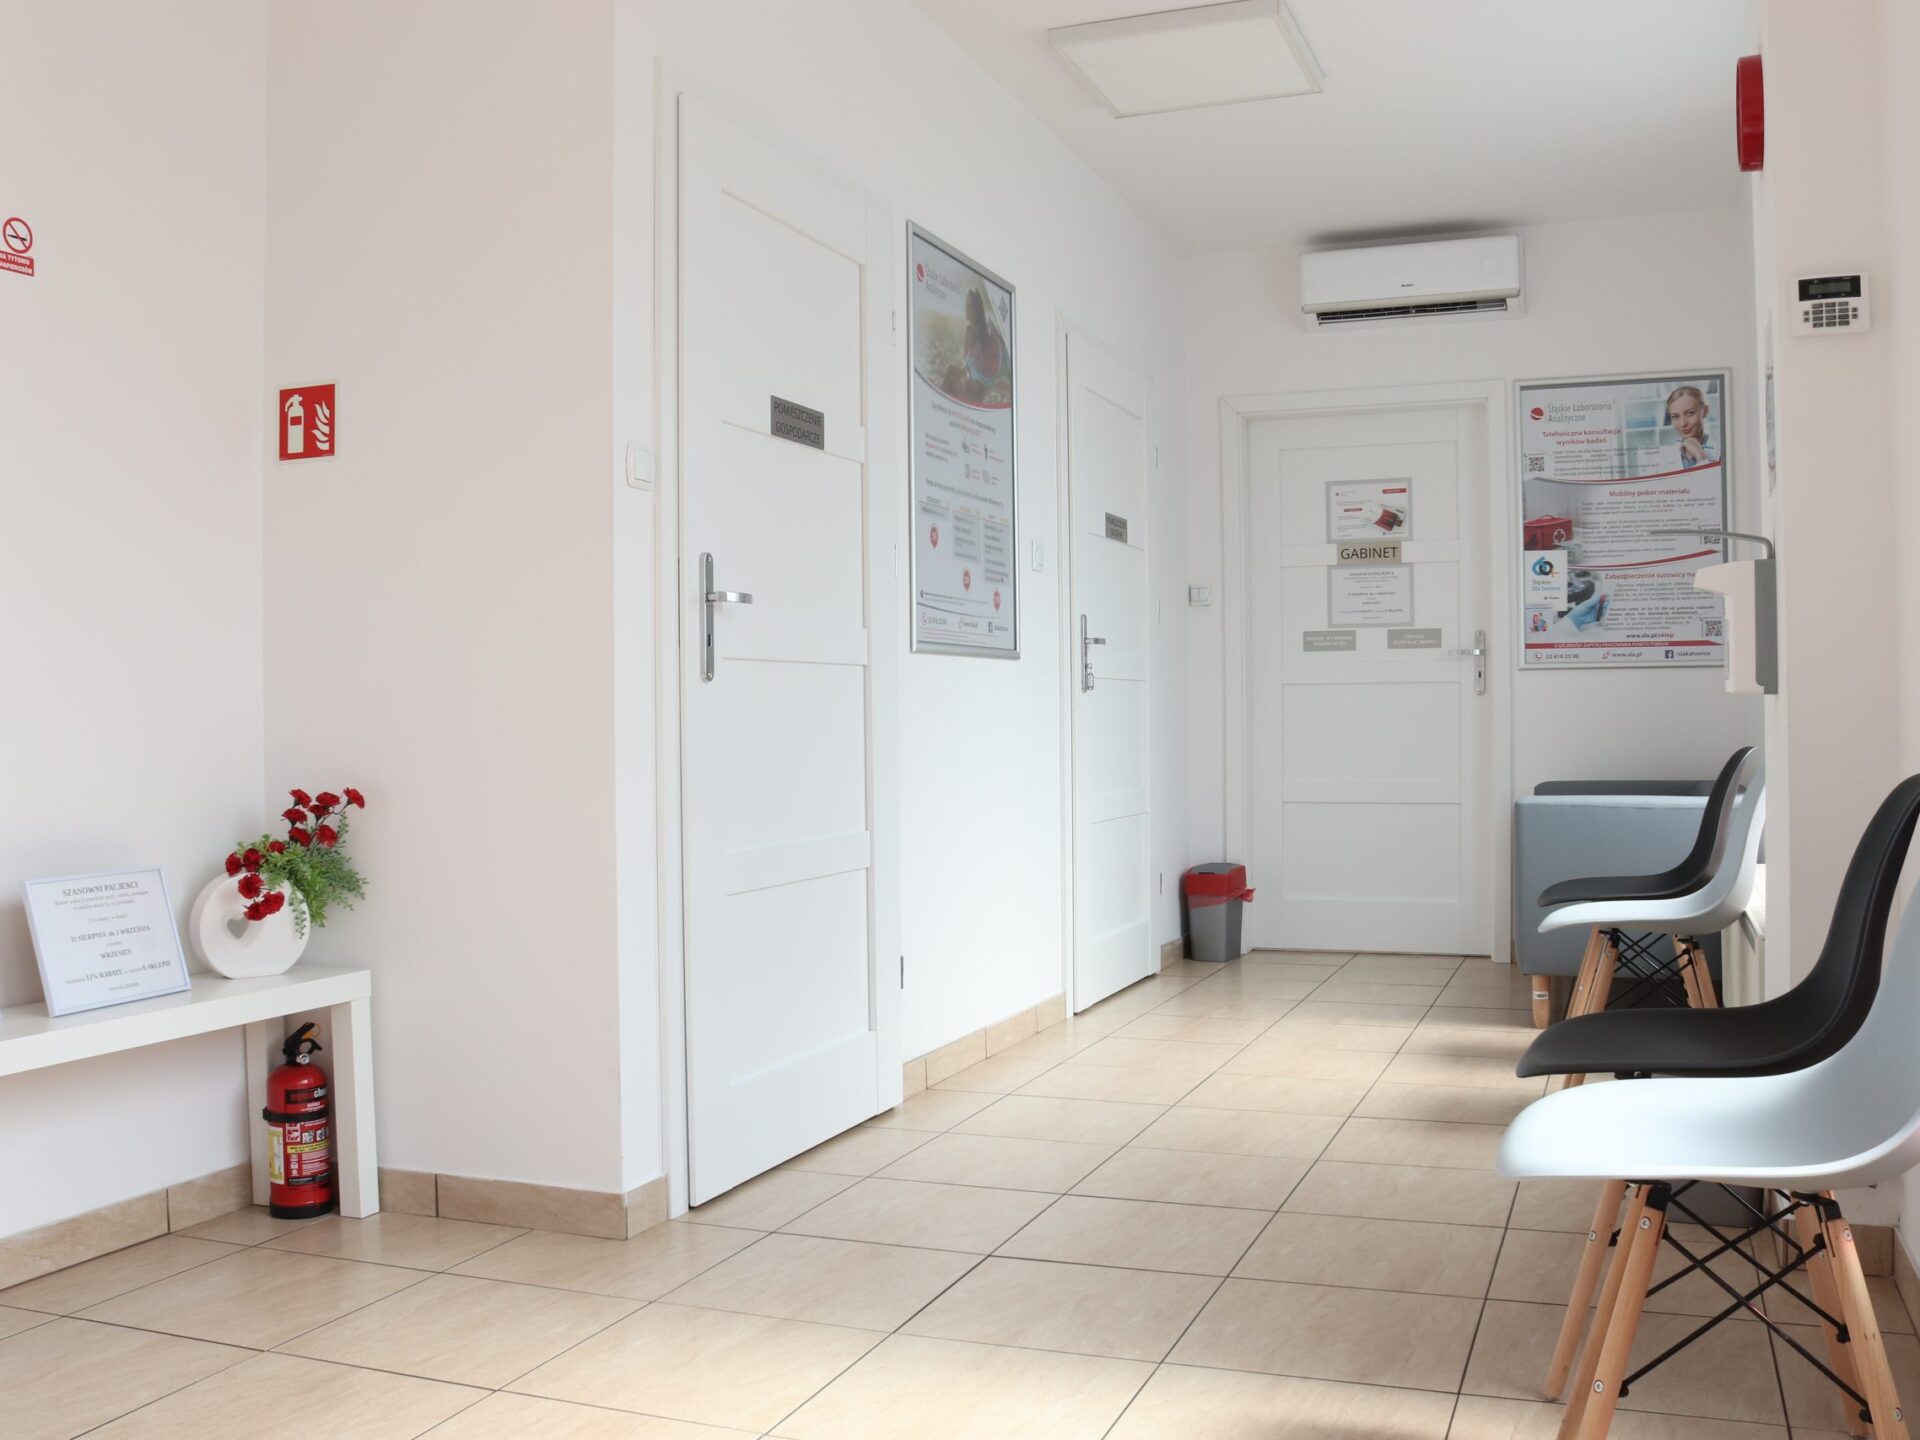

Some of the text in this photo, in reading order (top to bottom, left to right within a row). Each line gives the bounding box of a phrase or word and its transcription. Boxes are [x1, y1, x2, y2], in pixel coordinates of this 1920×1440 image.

[1573, 402, 1612, 412] Laboratoria
[1548, 414, 1585, 424] Analityczne
[1584, 429, 1621, 437] konsultacja
[1556, 438, 1584, 446] wyników
[1637, 489, 1657, 497] pobór
[1658, 487, 1691, 495] materiału
[1340, 547, 1398, 560] GABINET
[1605, 572, 1655, 580] Zabezpieczenie
[1656, 572, 1685, 580] surowicy
[62, 881, 139, 896] SZANOWNI PACJENCI
[78, 931, 107, 941] SIERPNIA
[120, 924, 151, 934] WRZEŚNIA
